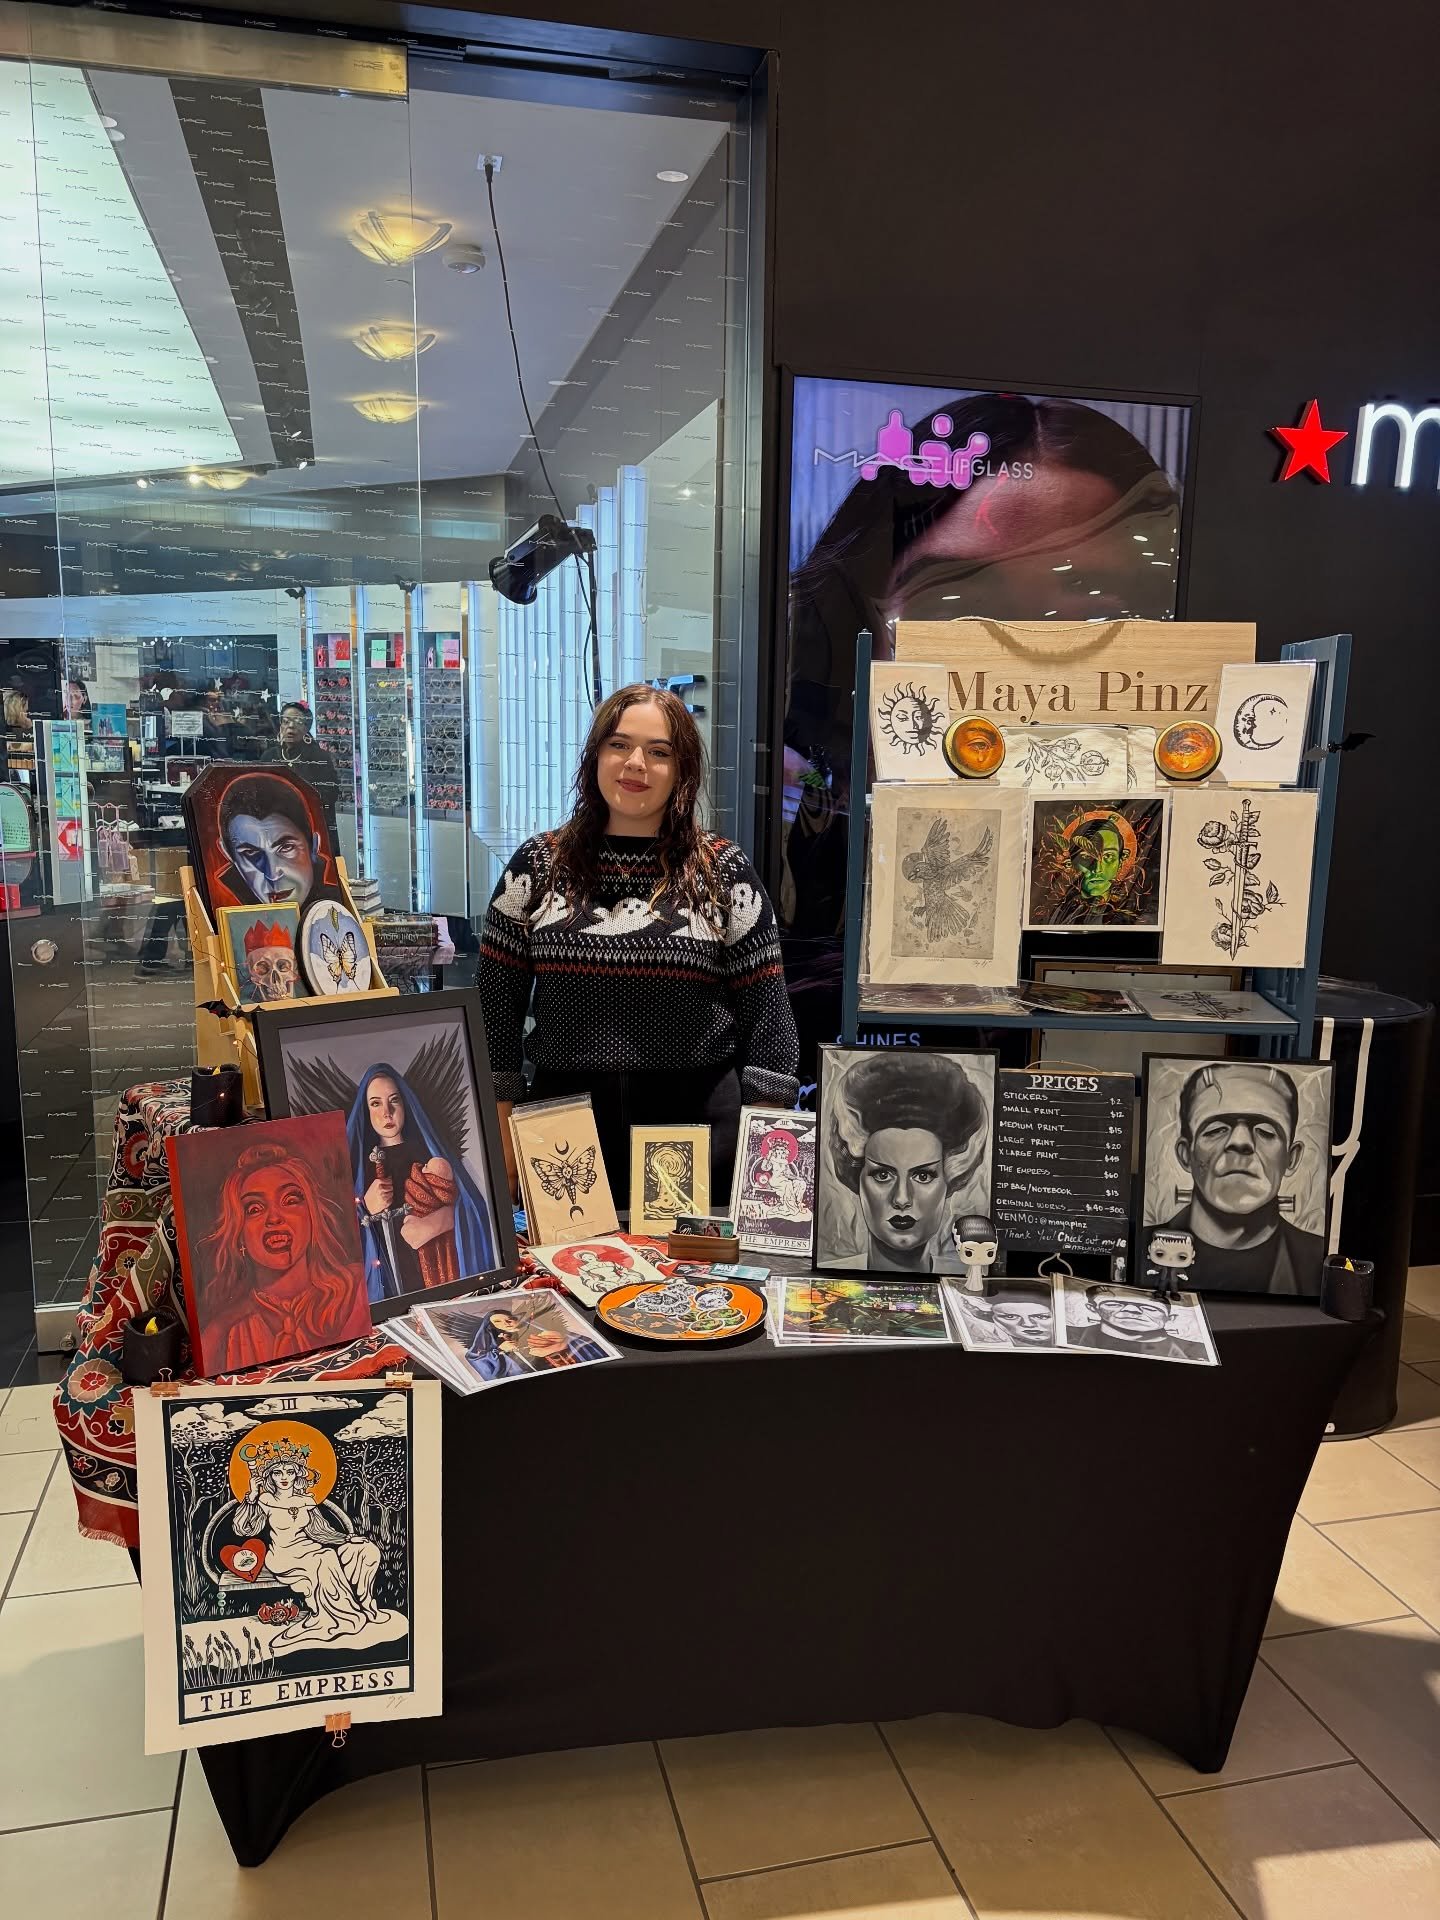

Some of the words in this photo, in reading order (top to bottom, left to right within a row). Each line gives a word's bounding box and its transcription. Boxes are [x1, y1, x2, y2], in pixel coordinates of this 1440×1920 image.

[944, 459, 1033, 479] LIPGLASS
[947, 671, 1076, 723] Maya
[1090, 671, 1209, 713] Pinz
[1030, 1075, 1099, 1091] PRICES
[1003, 1092, 1048, 1101] STICKERS
[1110, 1098, 1123, 1106] $2
[1002, 1106, 1031, 1114] SMALL
[1034, 1107, 1060, 1115] PRINT
[999, 1120, 1033, 1130] MEDIUM
[1038, 1124, 1064, 1132] PRINT
[1108, 1126, 1123, 1135] $15
[999, 1136, 1024, 1144] LARGE
[1031, 1138, 1055, 1146] PRINT
[1106, 1142, 1121, 1150] $20
[1036, 1151, 1058, 1159] PRINT
[997, 1164, 1013, 1173] THE
[1017, 1167, 1050, 1175] EMPRESS
[996, 1198, 1034, 1208] ORIGINAL
[1036, 1202, 1066, 1210] WORKS
[764, 1237, 807, 1248] EMPRESS
[1003, 1228, 1031, 1239] Thank
[1057, 1231, 1083, 1243] Check
[1085, 1235, 1099, 1245] out
[1101, 1239, 1116, 1248] my
[280, 1398, 298, 1410] III
[200, 1689, 252, 1713] THE
[276, 1670, 395, 1702] EMPRESS
